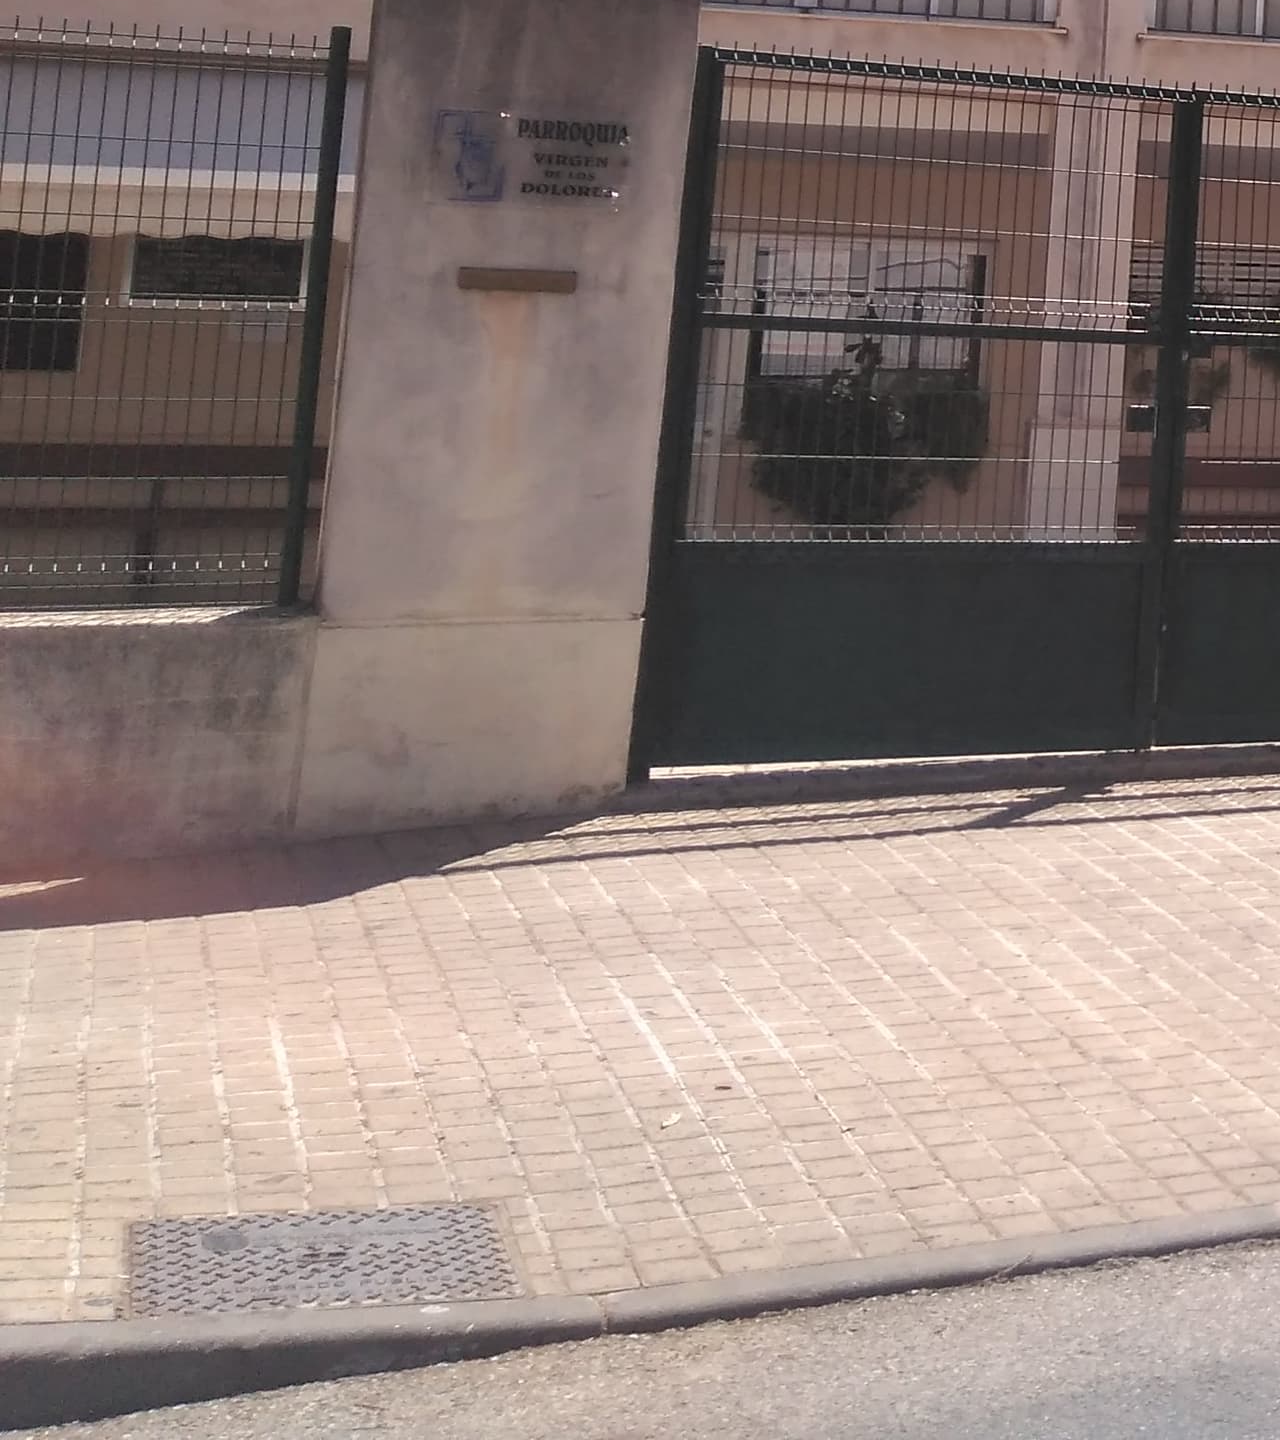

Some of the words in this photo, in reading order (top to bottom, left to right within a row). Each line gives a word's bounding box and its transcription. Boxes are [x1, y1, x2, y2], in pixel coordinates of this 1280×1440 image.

[518, 118, 630, 147] PARROQUIA
[533, 152, 609, 168] VIRGEN
[544, 170, 562, 179] DE
[568, 171, 596, 181] LOS
[520, 183, 615, 198] DOLORES
